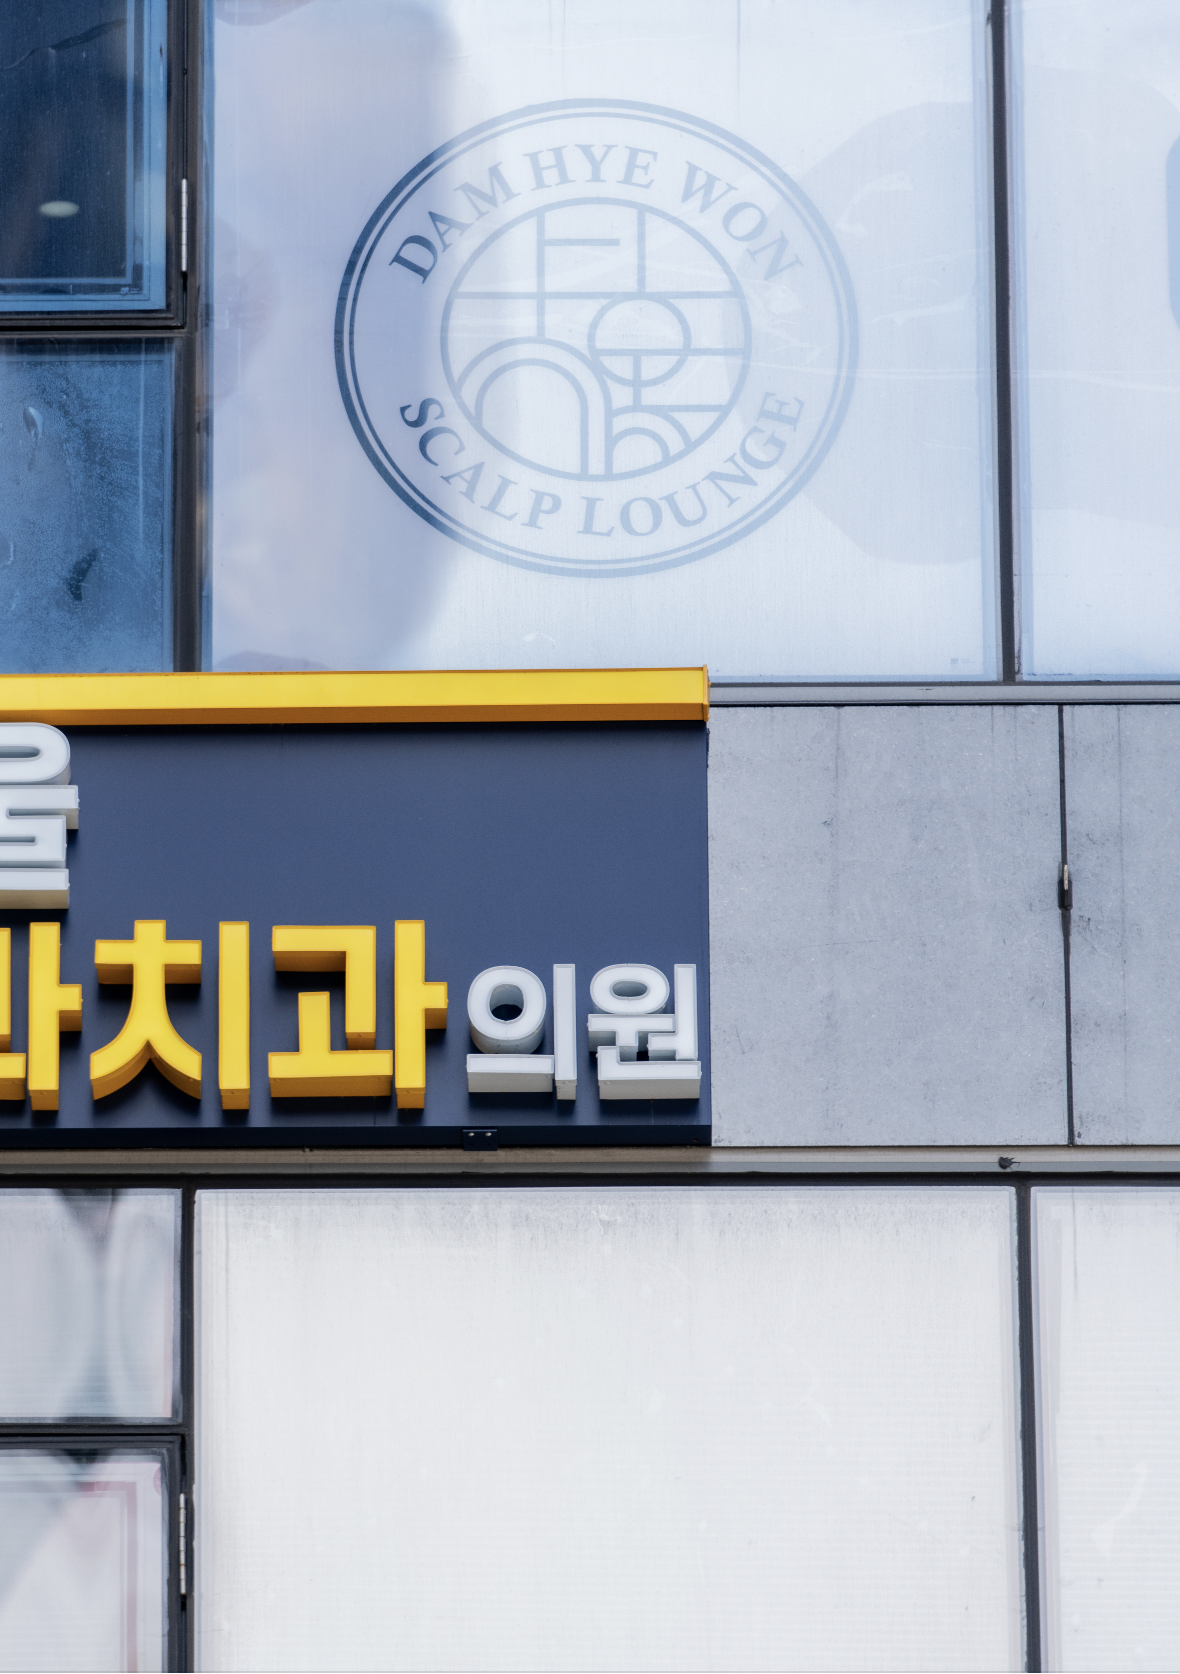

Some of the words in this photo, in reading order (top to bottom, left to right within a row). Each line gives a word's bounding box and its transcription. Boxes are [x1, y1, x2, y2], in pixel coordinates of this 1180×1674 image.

[389, 163, 520, 284] DAM
[523, 143, 659, 191] HYE
[680, 161, 805, 281] WON
[400, 397, 563, 529] SCALP
[577, 391, 805, 537] LOUNGE
